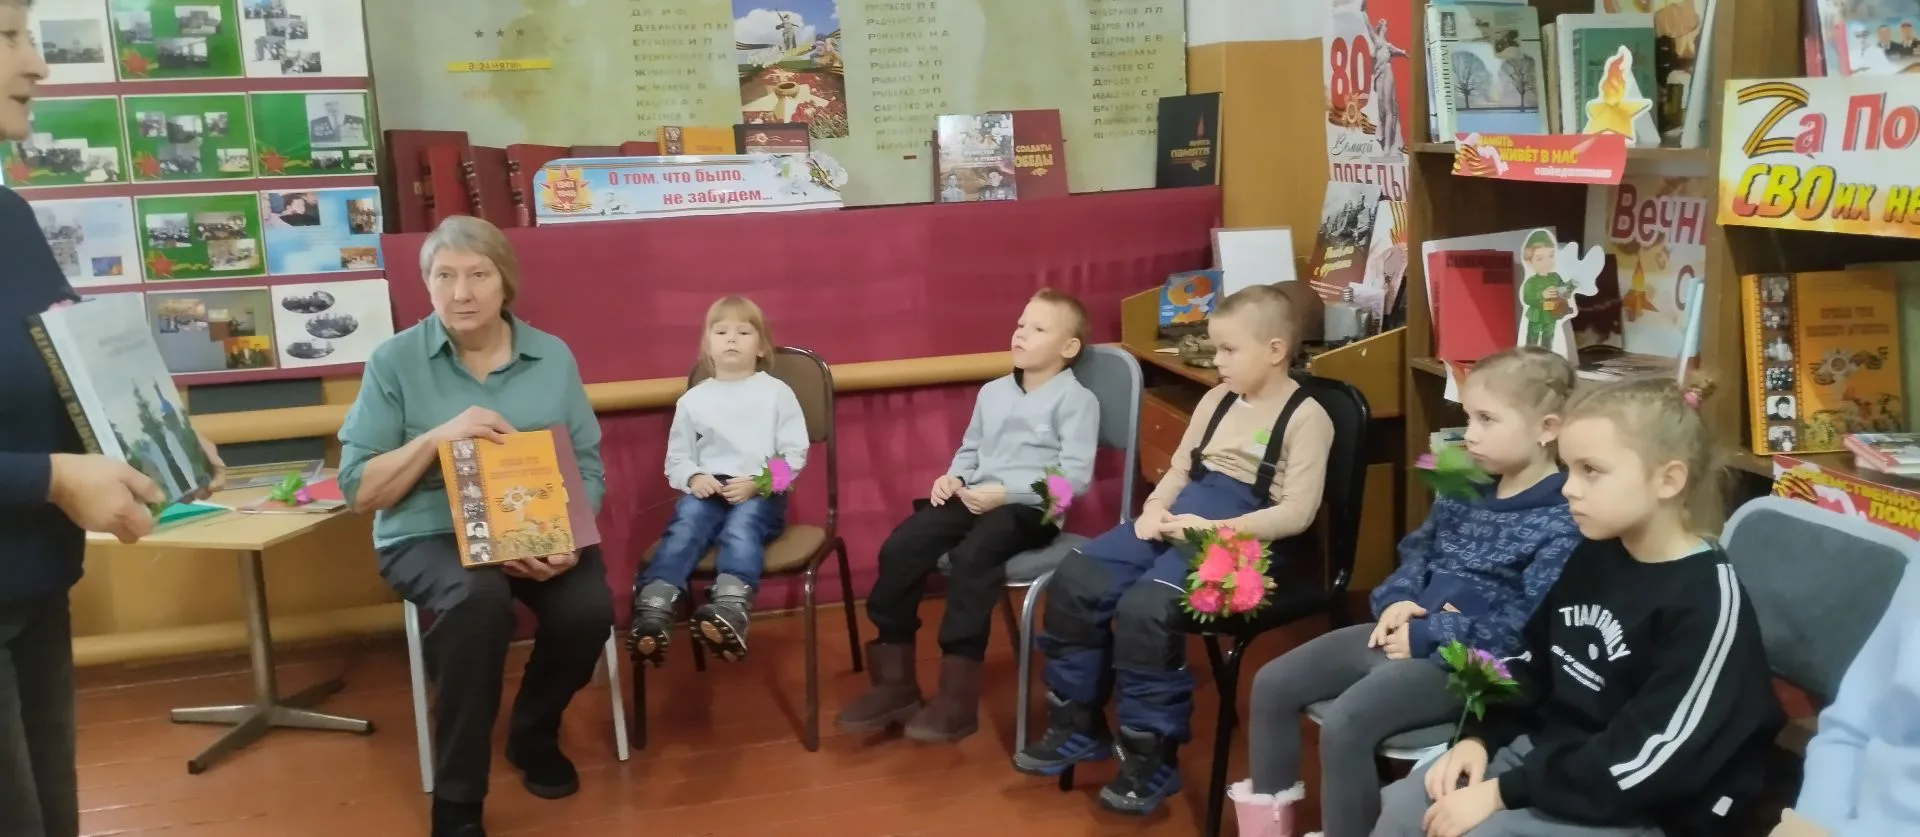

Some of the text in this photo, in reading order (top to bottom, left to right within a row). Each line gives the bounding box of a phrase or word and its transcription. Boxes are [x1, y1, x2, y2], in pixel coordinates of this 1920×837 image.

[1330, 35, 1373, 112] 80
[1540, 149, 1549, 164] В
[1552, 148, 1579, 165] НАС
[608, 171, 618, 186] О
[662, 172, 691, 185] что
[663, 192, 683, 205] не
